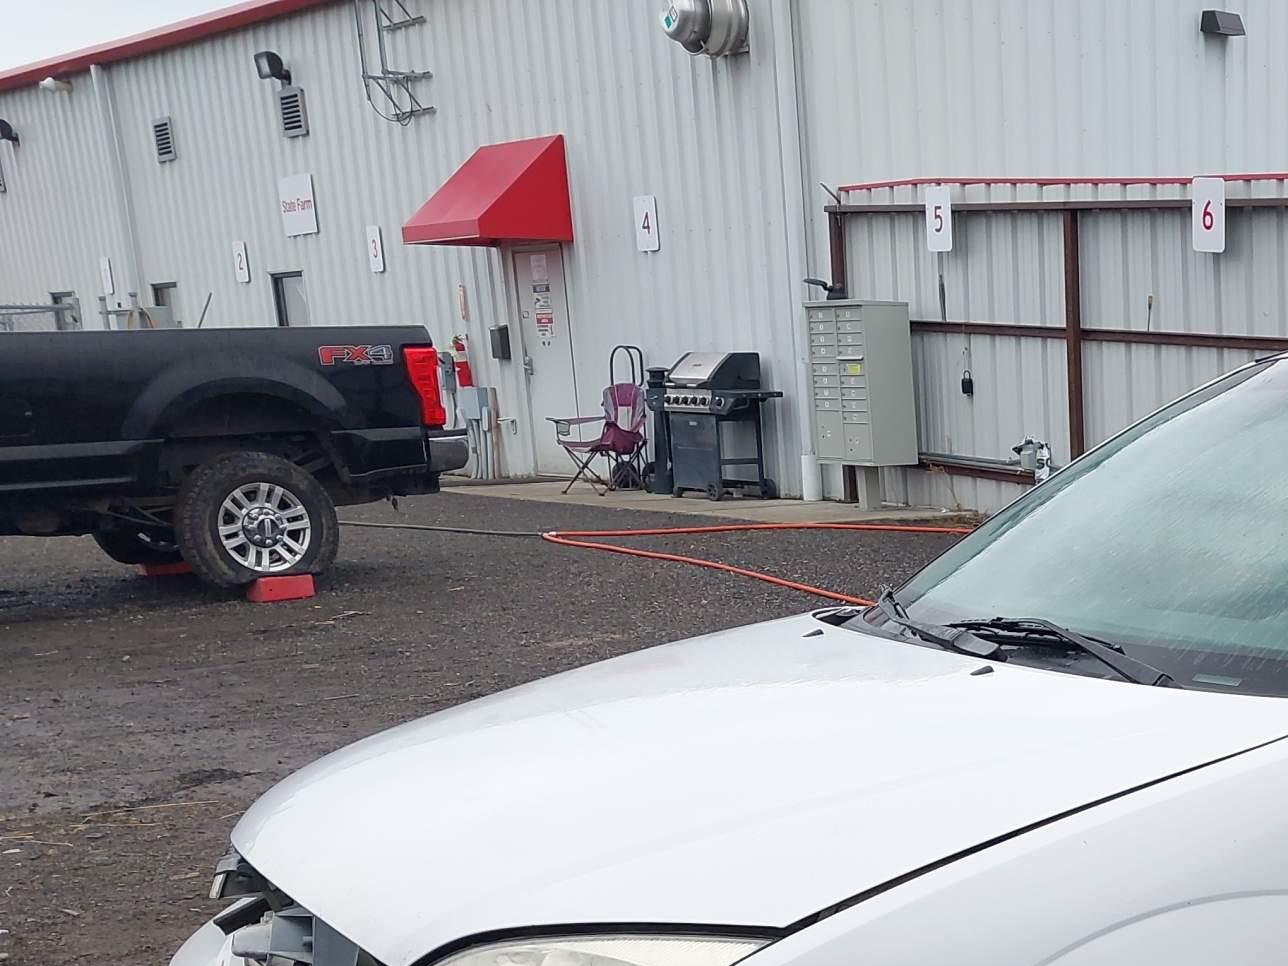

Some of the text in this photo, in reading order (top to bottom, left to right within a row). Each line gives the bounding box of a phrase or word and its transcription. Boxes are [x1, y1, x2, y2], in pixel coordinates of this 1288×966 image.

[281, 197, 313, 213] State Farm
[1202, 199, 1214, 231] 6
[641, 211, 651, 235] 4
[934, 205, 944, 233] 5
[371, 239, 378, 259] 3
[237, 252, 244, 271] 2
[318, 344, 394, 366] FX4
